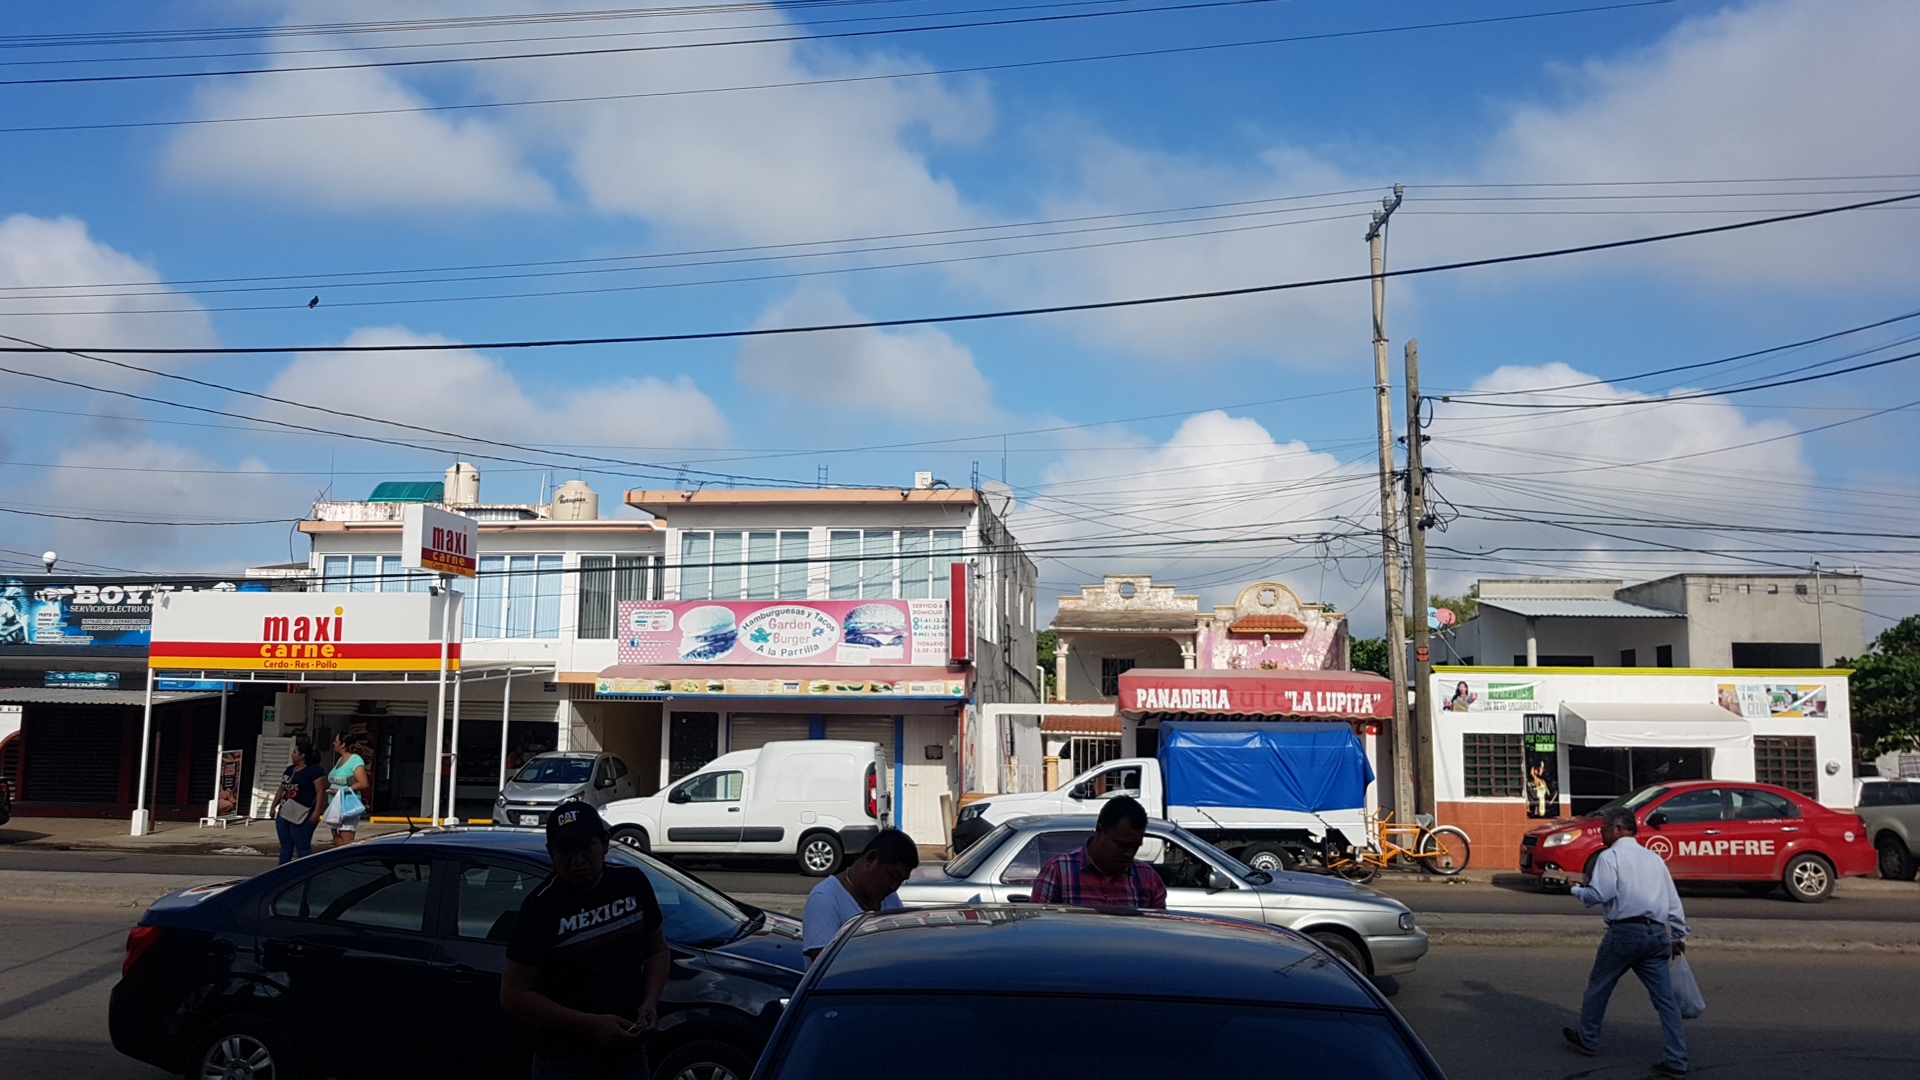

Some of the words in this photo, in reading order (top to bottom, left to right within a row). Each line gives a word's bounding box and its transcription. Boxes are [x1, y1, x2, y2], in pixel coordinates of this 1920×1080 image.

[432, 525, 468, 555] maxi
[432, 551, 466, 566] carne
[263, 606, 344, 642] maxi
[742, 608, 805, 631] Hamburguesas
[814, 613, 835, 632] Tacos
[768, 618, 811, 630] Garden
[773, 633, 811, 646] Burger
[260, 644, 335, 658] carne
[756, 645, 764, 653] A
[767, 648, 776, 656] la
[781, 644, 820, 657] Parrilla
[264, 660, 289, 668] Cerdo
[295, 660, 310, 668] Res
[315, 660, 338, 668] Pollo
[1136, 688, 1231, 710] PANADERIA
[1285, 691, 1313, 711] "LA
[1317, 691, 1381, 713] LUPITA"
[558, 811, 577, 826] CAT
[1679, 839, 1775, 856] MAPFRE
[557, 896, 638, 935] MÉXICO
